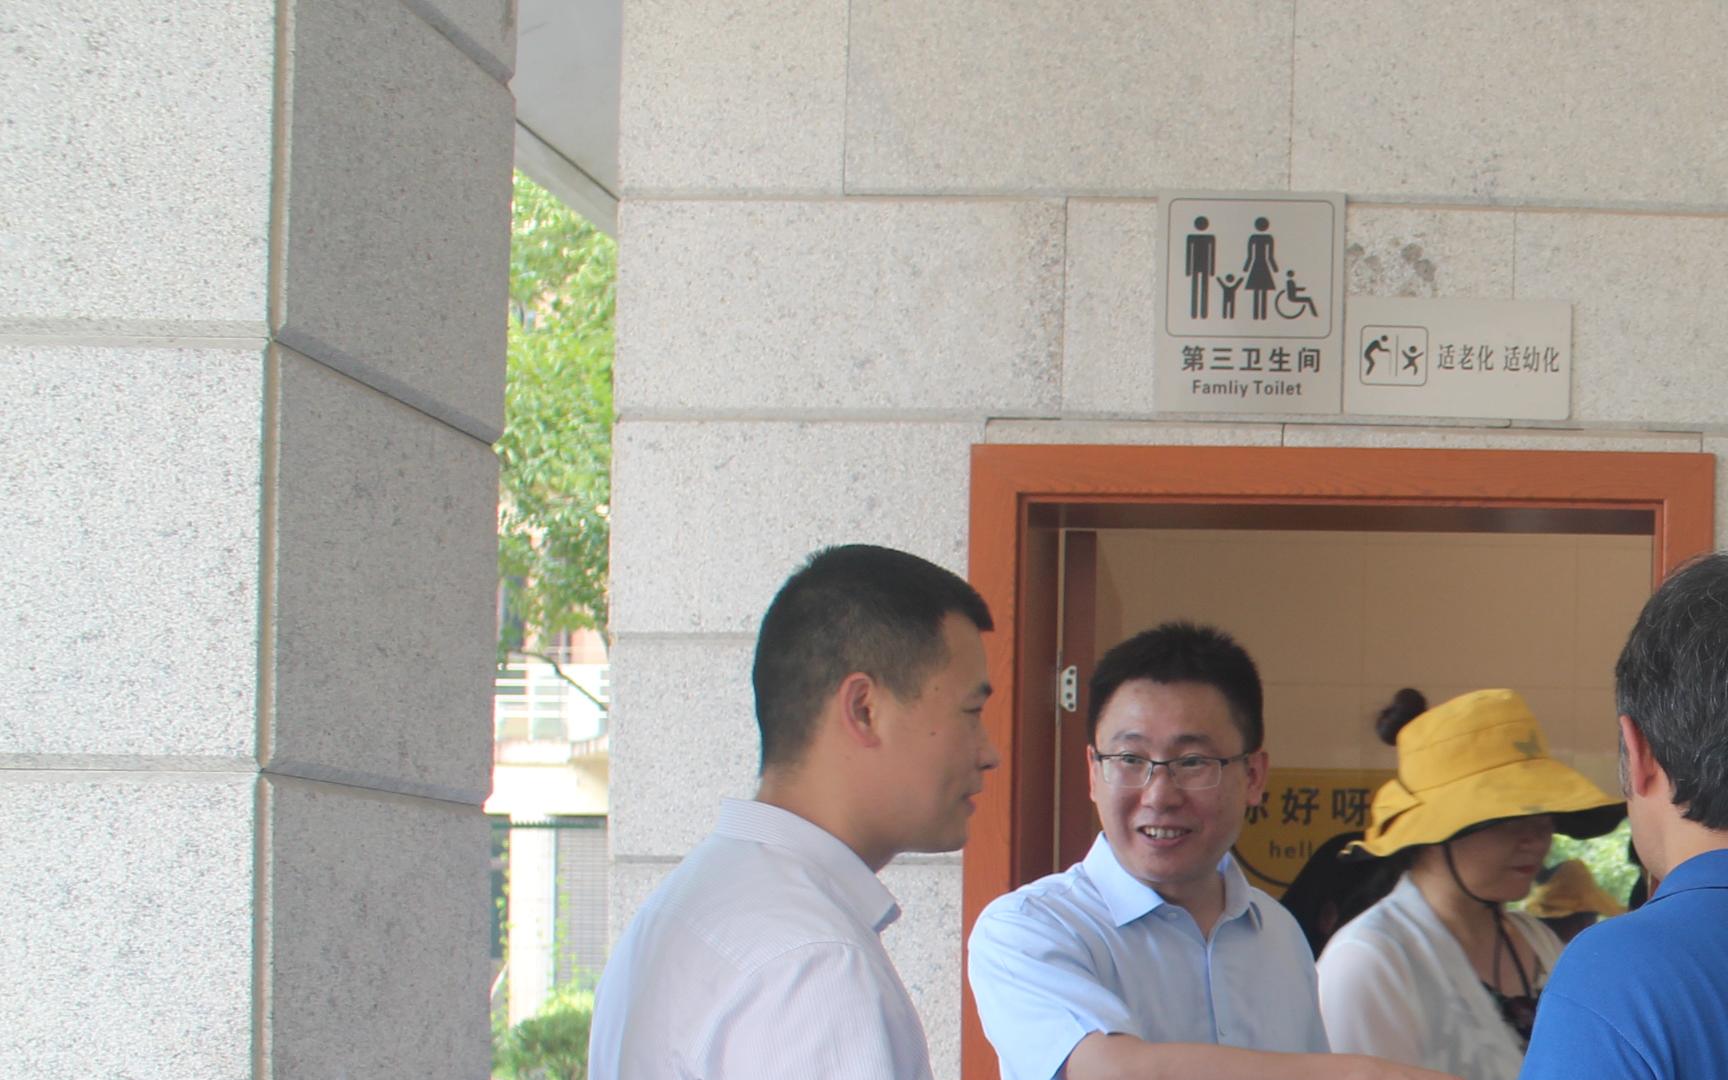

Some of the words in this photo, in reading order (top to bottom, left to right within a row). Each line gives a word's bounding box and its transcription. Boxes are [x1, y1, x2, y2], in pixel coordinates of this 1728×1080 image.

[1181, 345, 1321, 373] 第三卫生间
[1437, 344, 1495, 371] 适老化
[1253, 380, 1303, 396] Toilet
